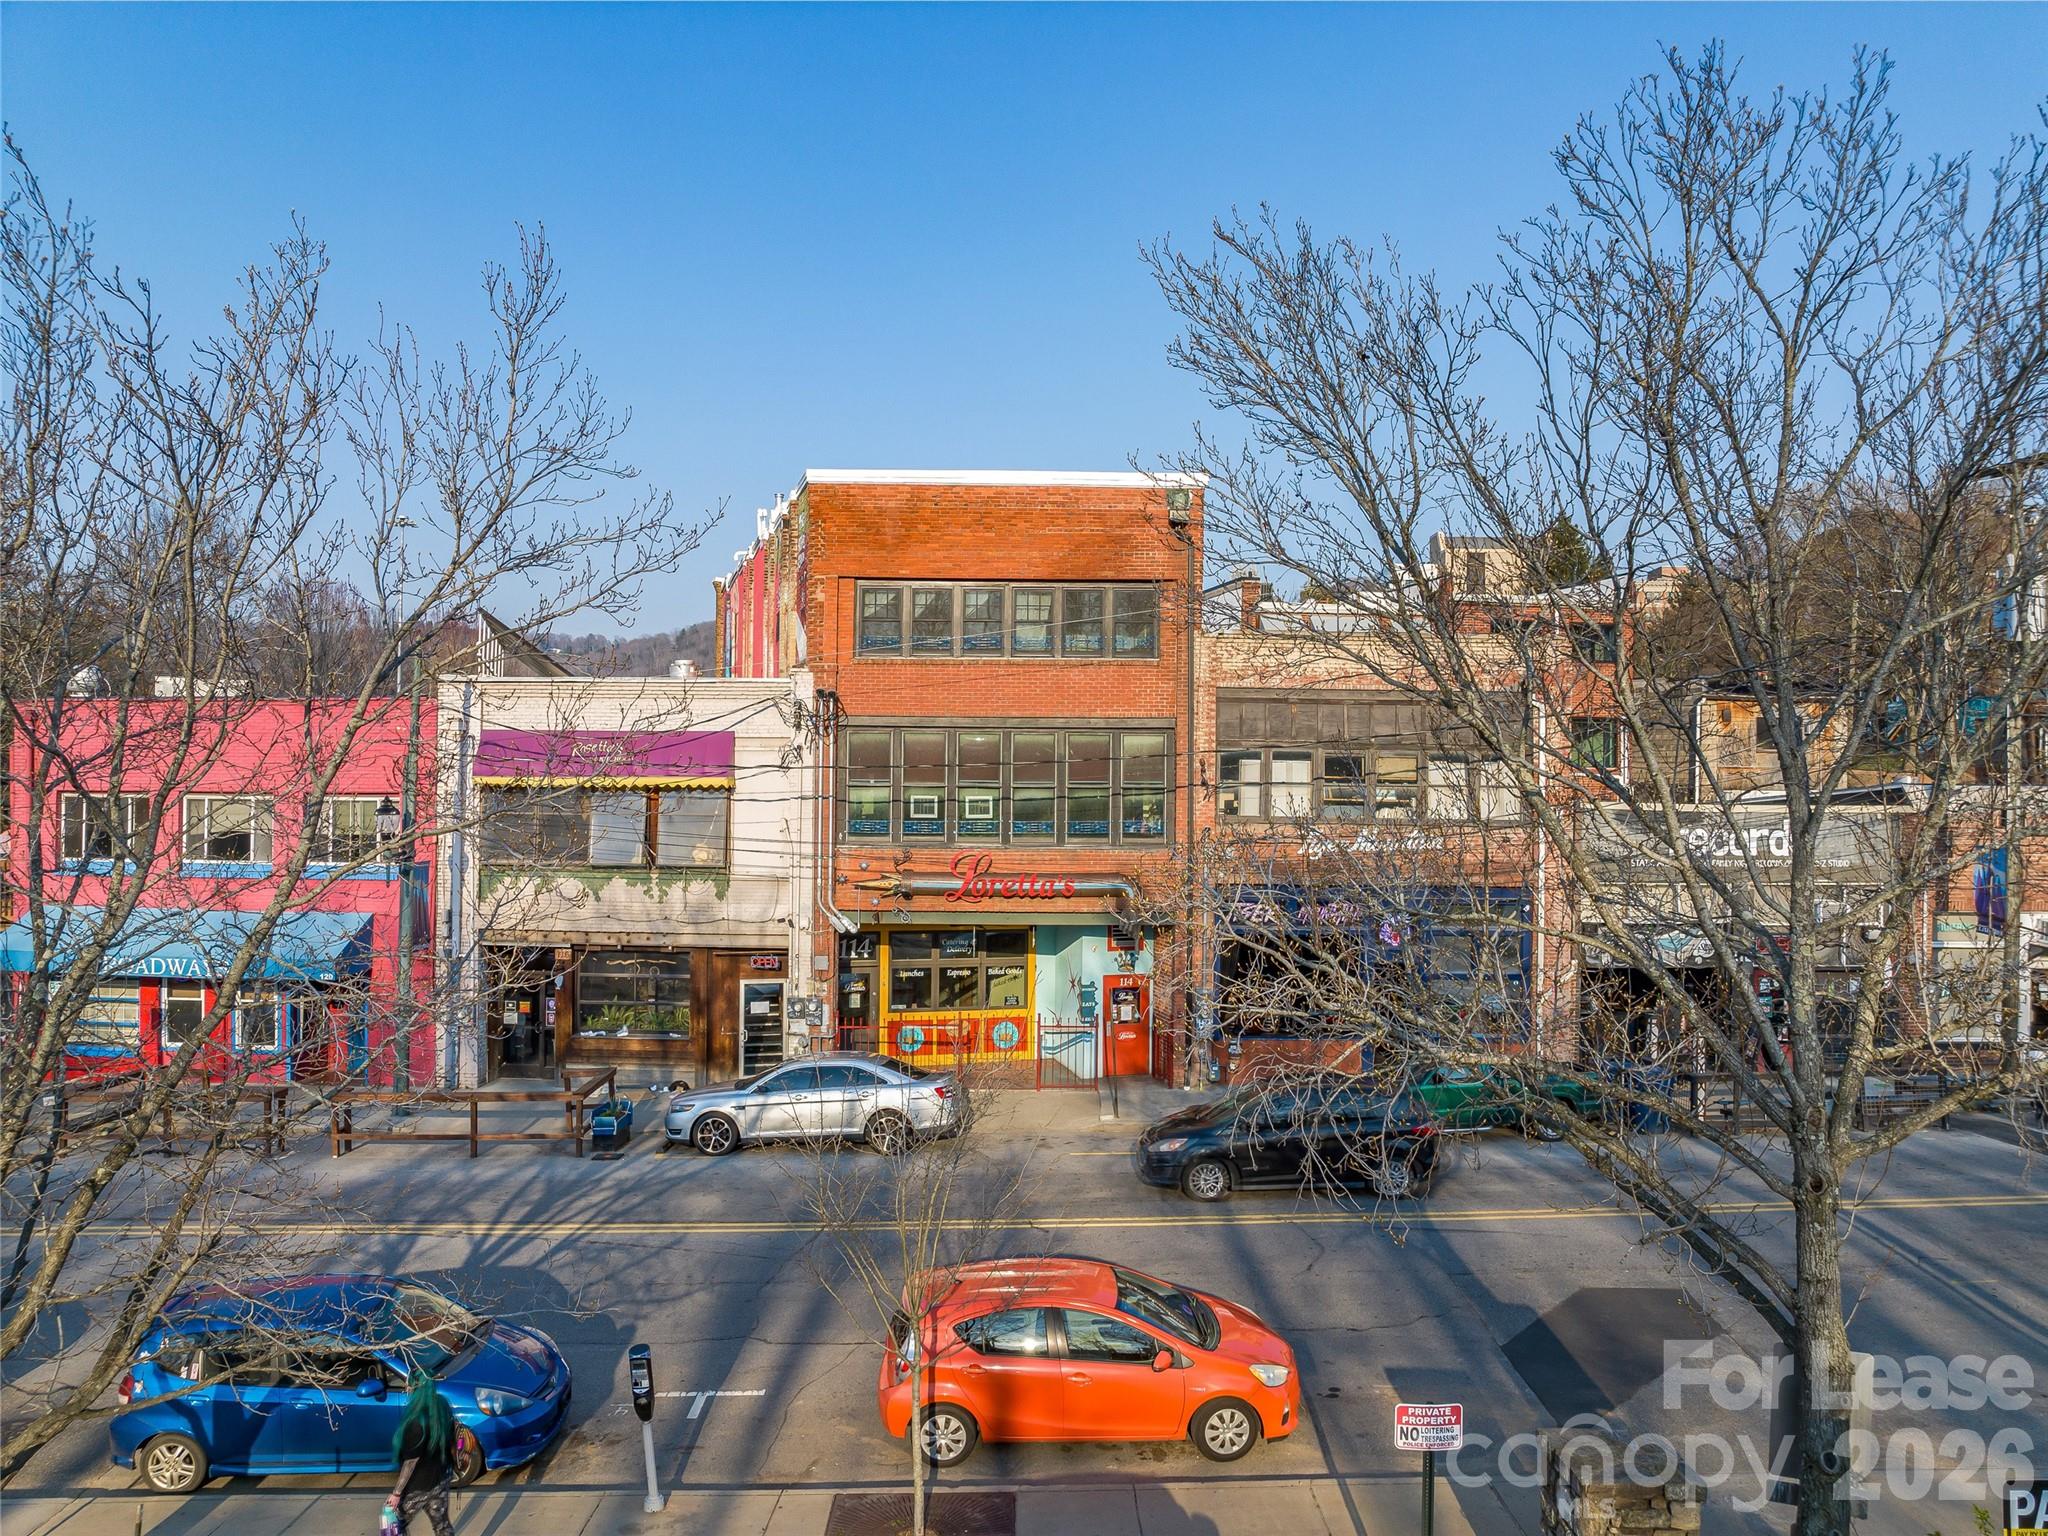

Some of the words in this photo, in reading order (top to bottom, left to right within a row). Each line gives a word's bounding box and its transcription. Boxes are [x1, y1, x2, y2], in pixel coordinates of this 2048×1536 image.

[944, 848, 1076, 903] Loretta's
[839, 938, 873, 958] 114
[946, 944, 973, 955] Delivery
[752, 957, 778, 967] OPEN
[898, 969, 924, 977] Lunches
[987, 968, 1005, 976] Baked
[1119, 978, 1133, 986] 114
[1408, 1407, 1451, 1416] PRIVATE
[1402, 1416, 1457, 1425] PROPERTY
[1399, 1426, 1420, 1442] NO
[1420, 1426, 1455, 1434] LOITERING
[1421, 1434, 1459, 1442] TRESPASSING
